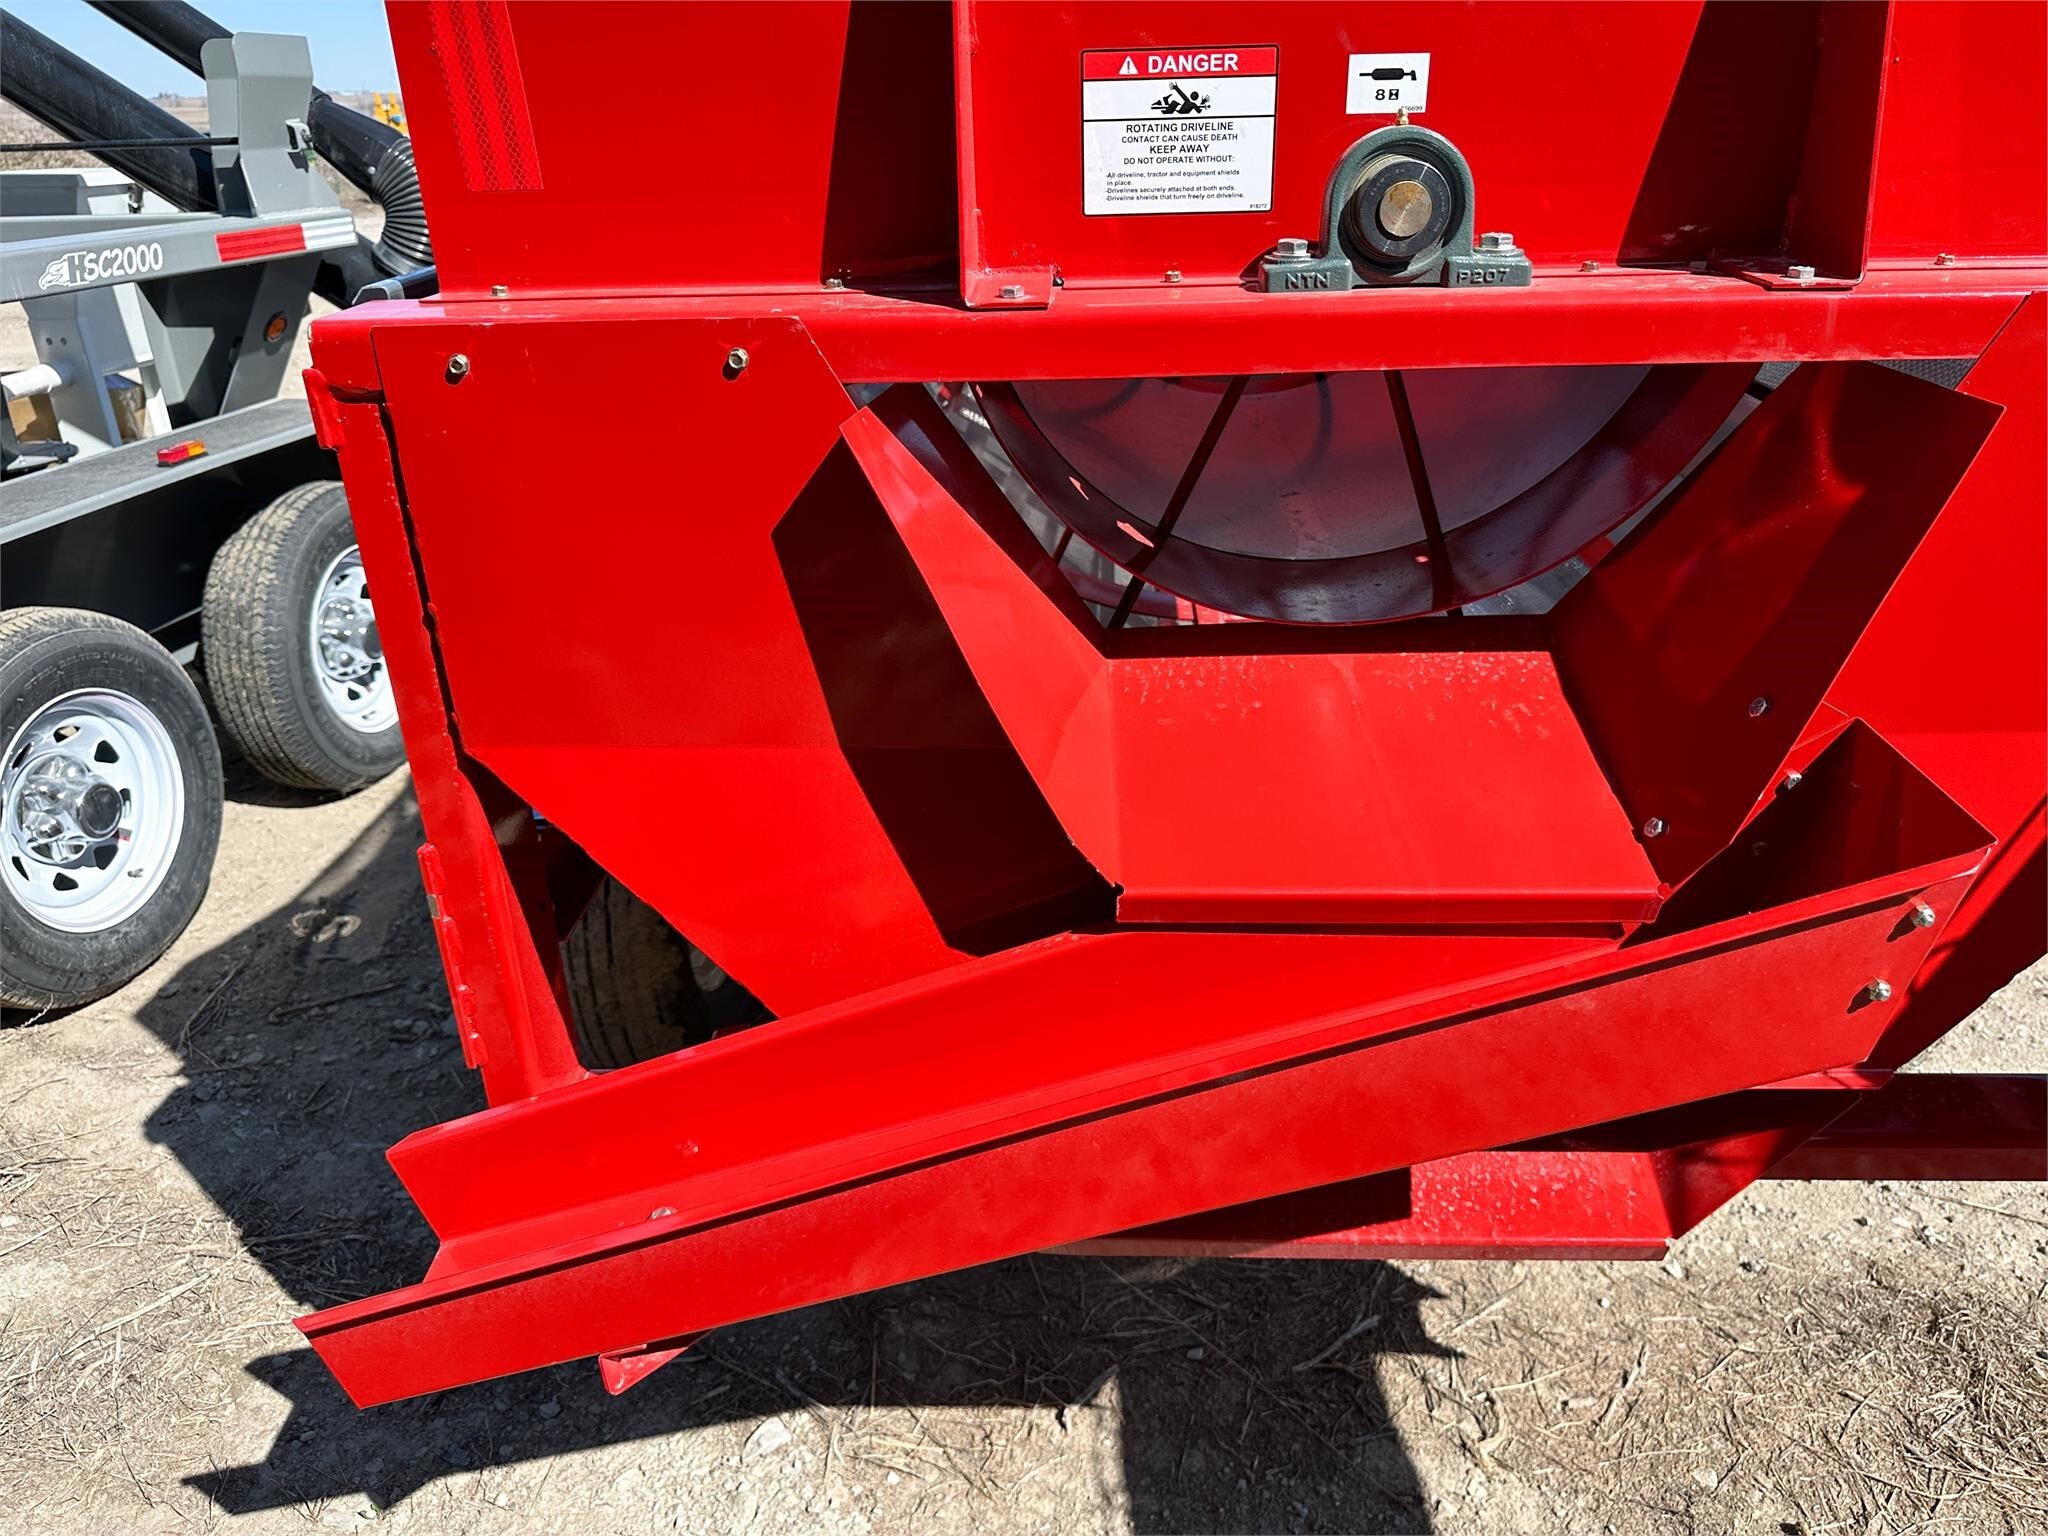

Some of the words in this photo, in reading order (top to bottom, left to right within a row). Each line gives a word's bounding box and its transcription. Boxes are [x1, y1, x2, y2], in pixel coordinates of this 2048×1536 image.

[1148, 53, 1239, 73] DANGER
[1375, 88, 1386, 101] 8
[1126, 123, 1178, 133] ROTATING
[1181, 121, 1234, 131] DRIVELINE
[1121, 135, 1160, 143] CONTACT
[1162, 134, 1179, 142] CAN
[1181, 133, 1209, 142] CAUSE
[1210, 133, 1238, 141] DEATH
[1149, 145, 1177, 154] KEEP
[1179, 144, 1210, 153] AWAY
[1123, 157, 1136, 165] DO
[1138, 156, 1154, 164] NOT
[1156, 156, 1194, 164] OPERATE
[1195, 155, 1236, 163] WITHOUT:
[1284, 272, 1331, 290] NTN
[1456, 267, 1510, 285] P207
